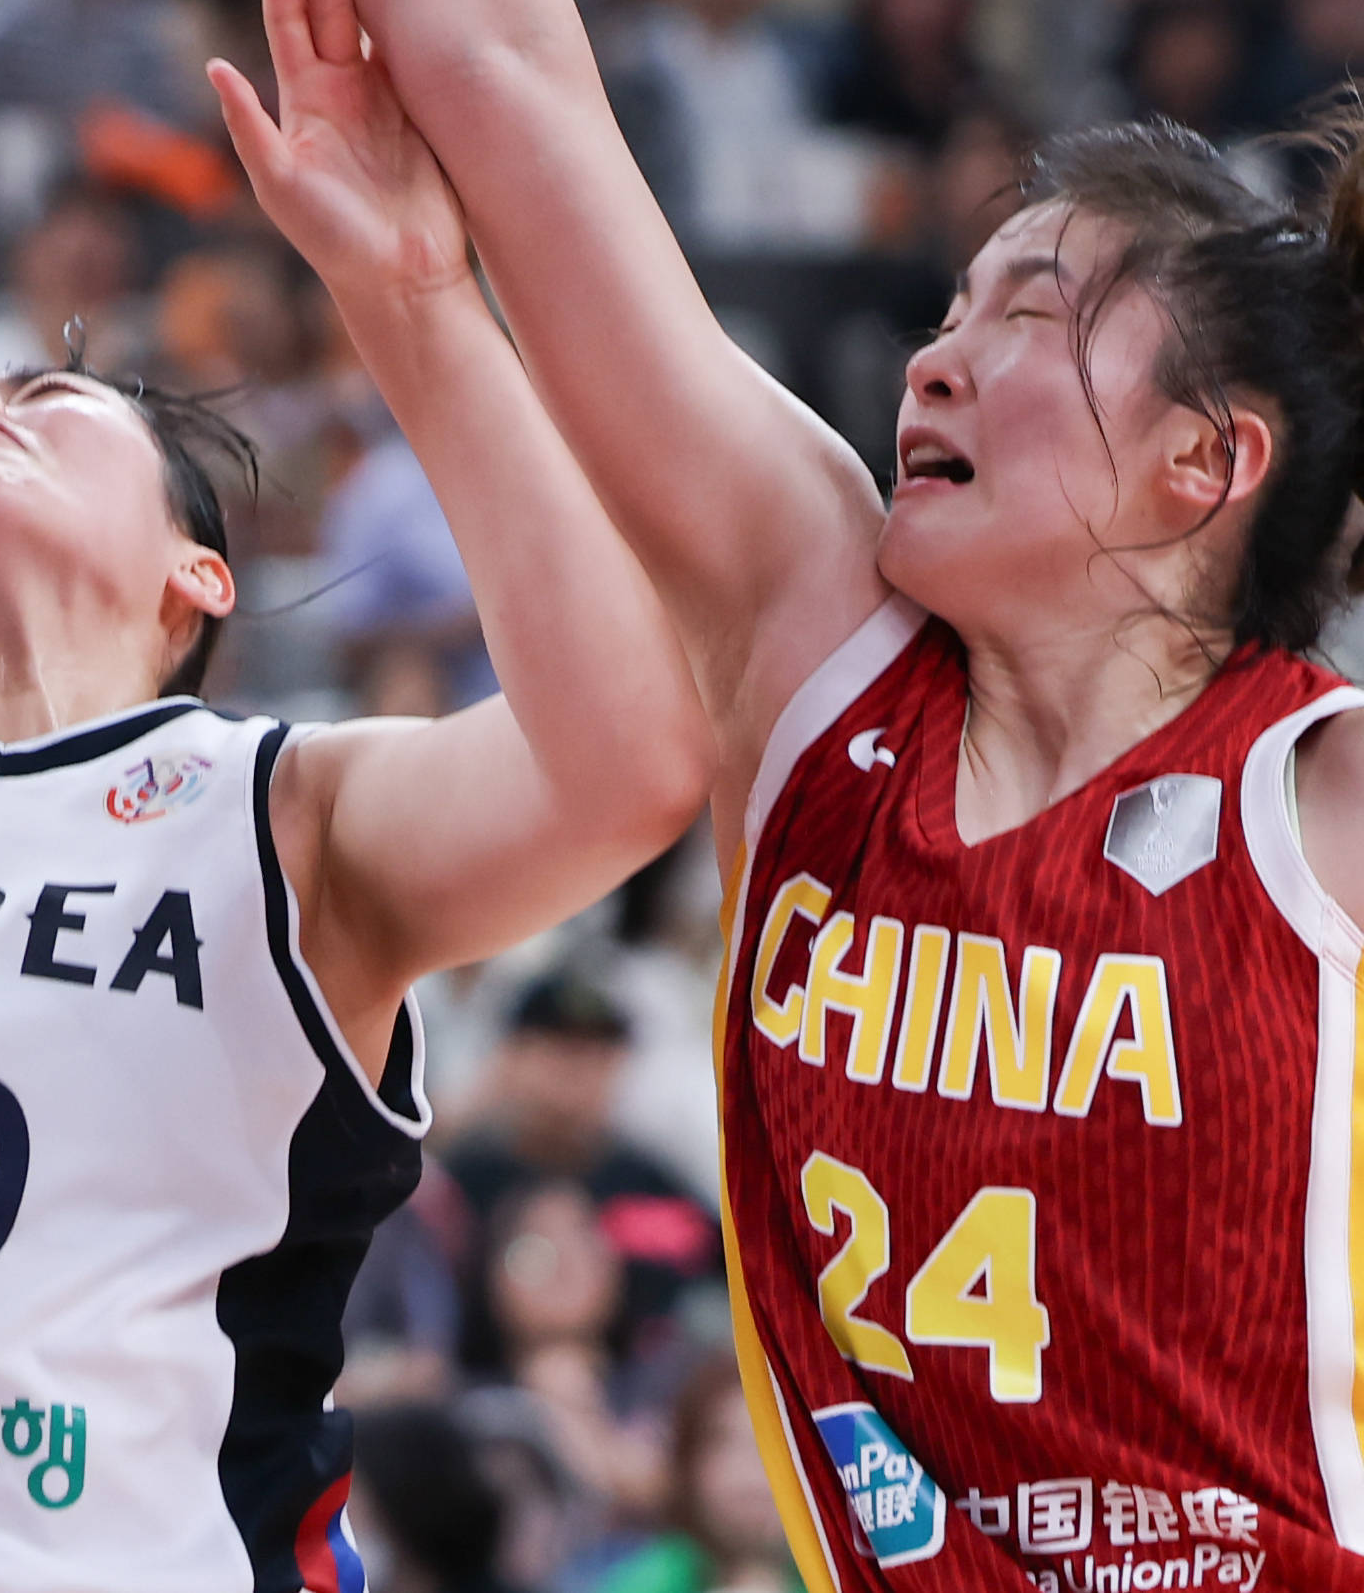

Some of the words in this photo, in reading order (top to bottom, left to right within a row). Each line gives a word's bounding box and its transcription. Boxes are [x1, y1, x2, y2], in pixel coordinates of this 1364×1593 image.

[750, 871, 1183, 1127] CHINA
[800, 1149, 1050, 1404] 24
[1063, 1542, 1266, 1593] UnionPay
